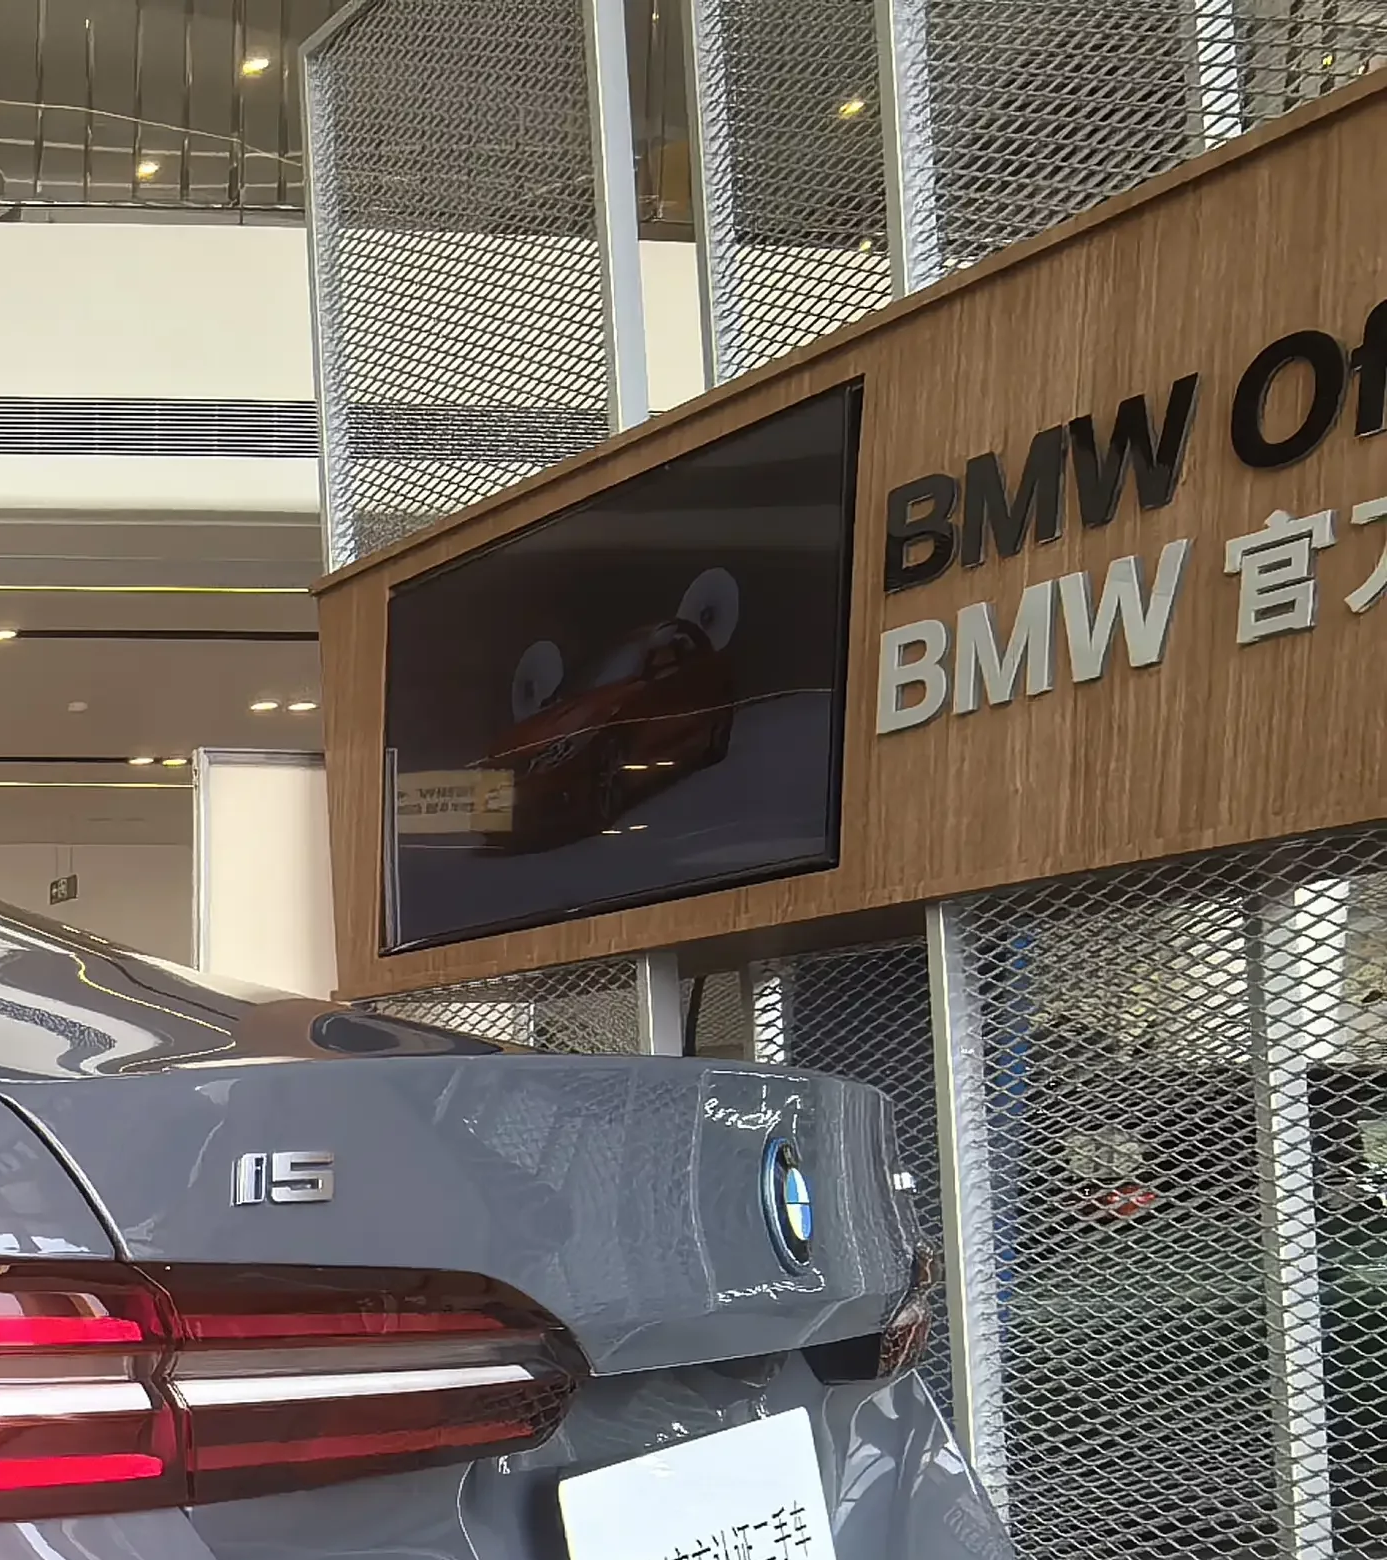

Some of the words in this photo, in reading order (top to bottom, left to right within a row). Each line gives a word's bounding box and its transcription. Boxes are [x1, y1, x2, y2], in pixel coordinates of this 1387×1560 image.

[884, 371, 1200, 595] BMW
[876, 539, 1191, 735] BMW
[230, 1150, 334, 1206] i5
